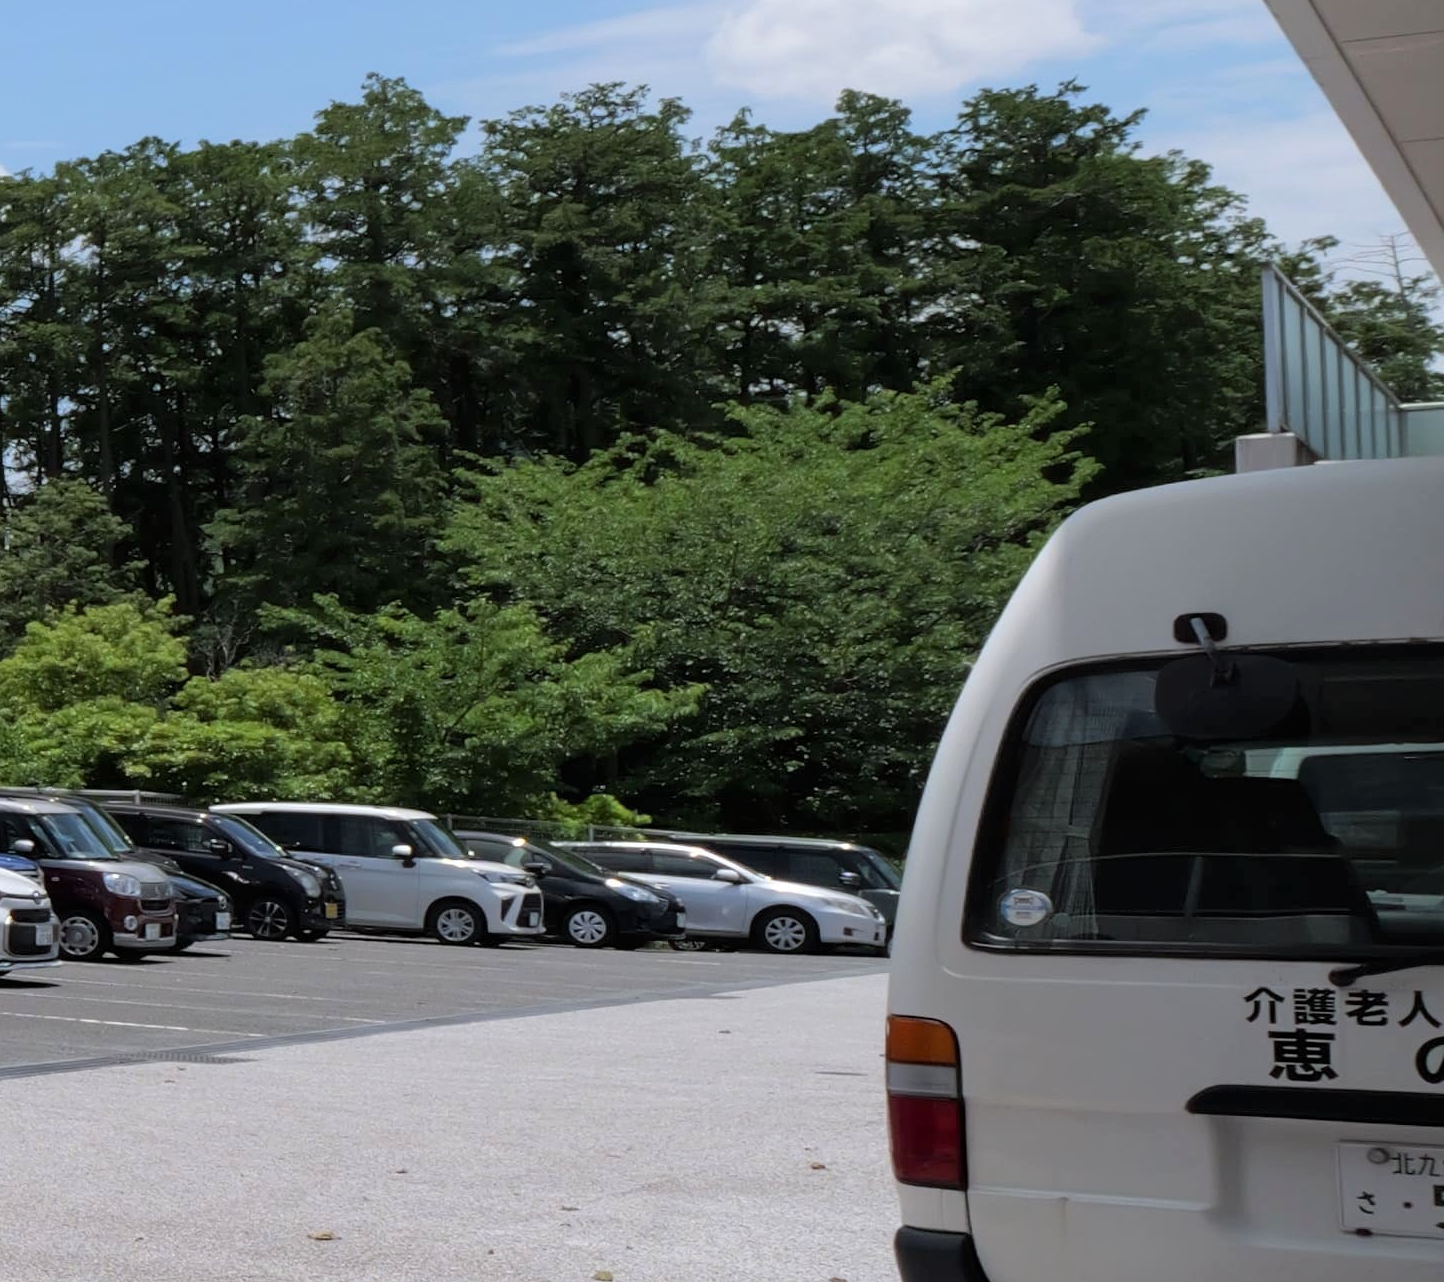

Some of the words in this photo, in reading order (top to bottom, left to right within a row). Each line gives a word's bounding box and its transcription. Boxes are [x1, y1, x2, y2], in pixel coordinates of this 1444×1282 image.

[1244, 987, 1442, 1028] 介護老人
[1390, 1153, 1444, 1177] 北九
